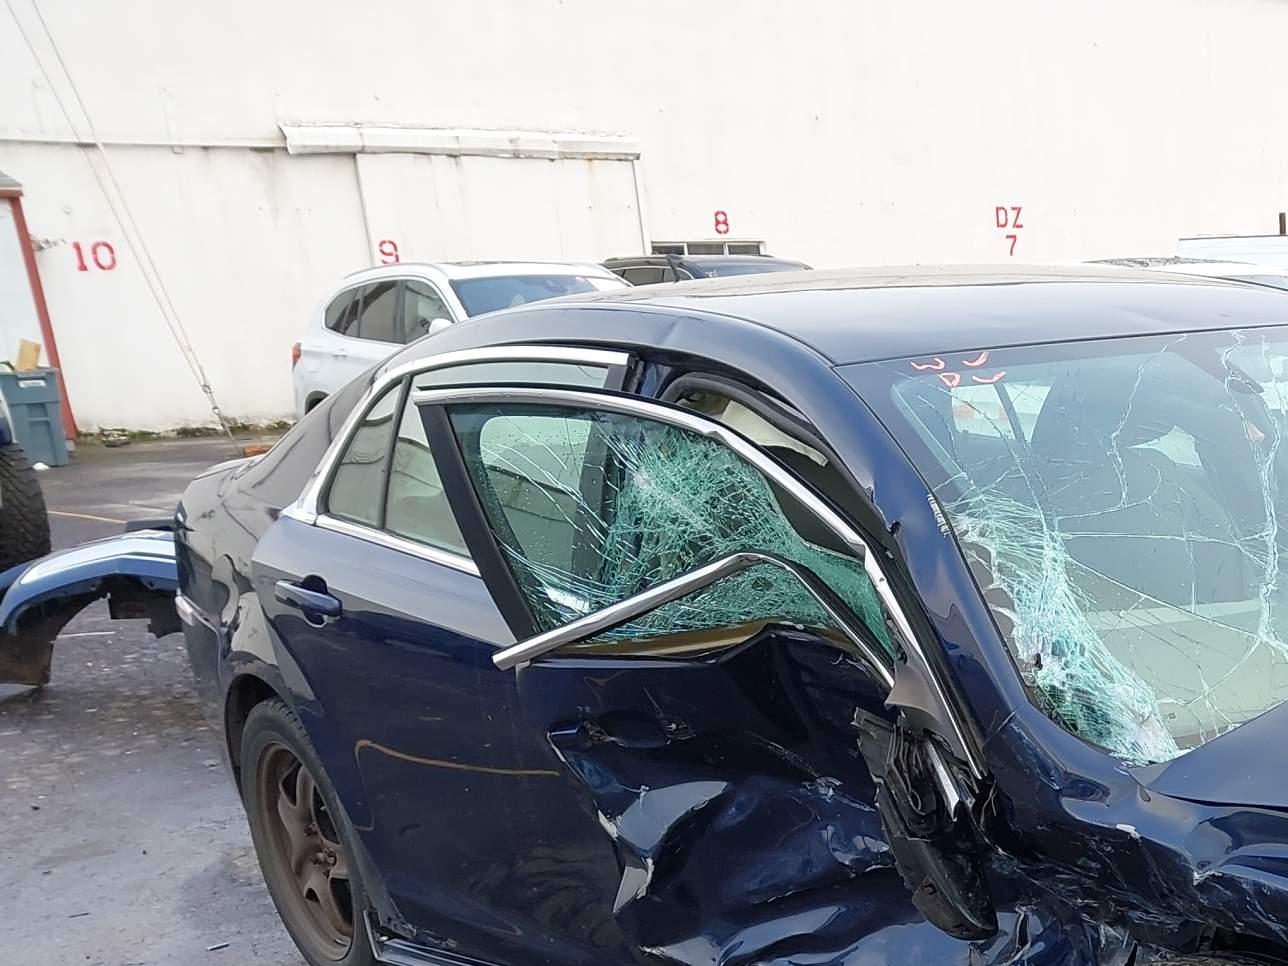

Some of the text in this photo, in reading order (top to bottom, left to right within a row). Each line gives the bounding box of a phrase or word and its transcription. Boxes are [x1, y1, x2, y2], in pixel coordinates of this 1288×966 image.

[713, 210, 731, 234] 8
[995, 206, 1024, 229] DZ
[72, 241, 117, 272] 10
[378, 239, 401, 264] 9
[1005, 234, 1018, 257] 7
